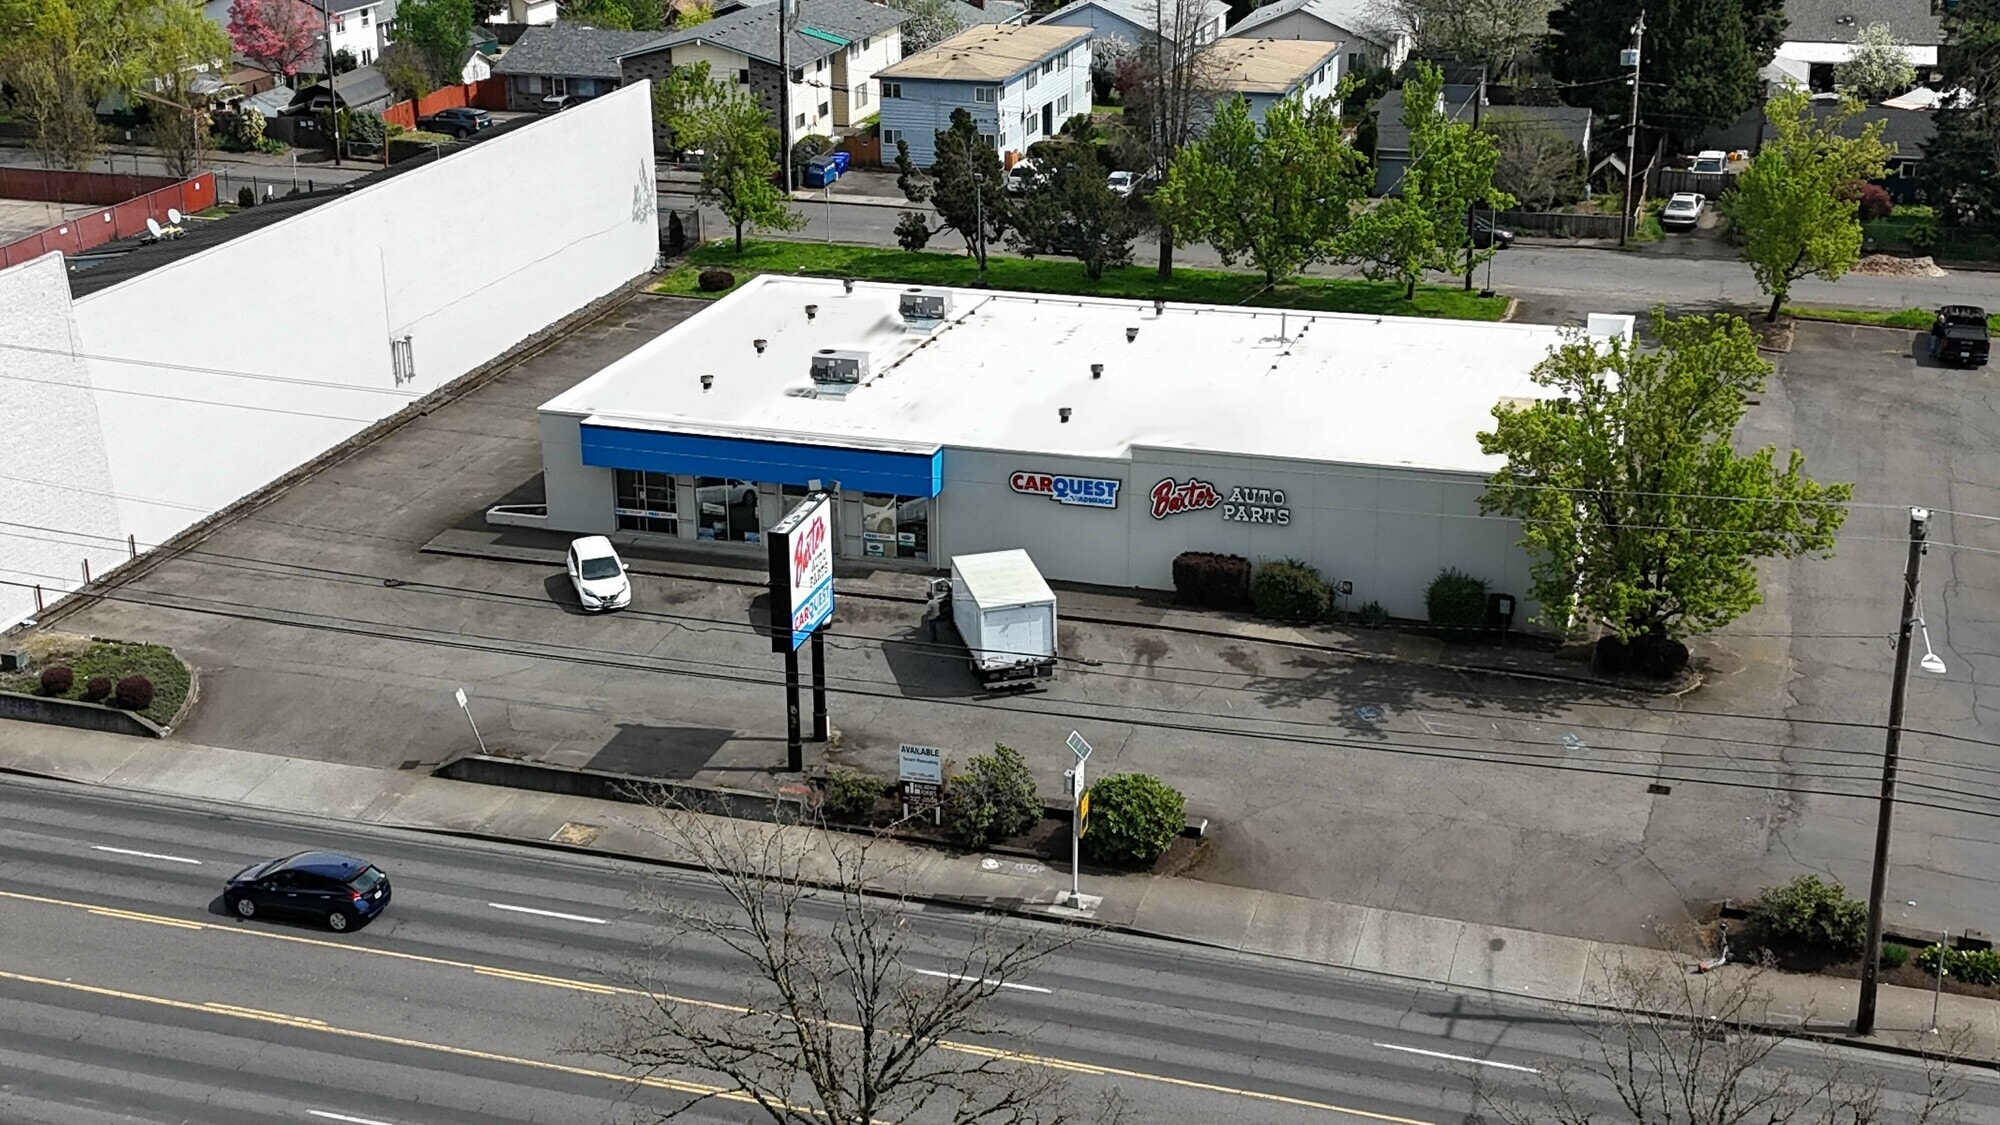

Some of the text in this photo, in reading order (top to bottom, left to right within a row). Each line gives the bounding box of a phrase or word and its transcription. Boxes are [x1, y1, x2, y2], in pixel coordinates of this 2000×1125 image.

[1012, 474, 1117, 498] CARQUEST
[1153, 480, 1286, 518] Baxter AUTO
[1223, 504, 1290, 525] PARTS
[794, 585, 830, 631] CARQUEST
[901, 745, 940, 757] AVAILABLE
